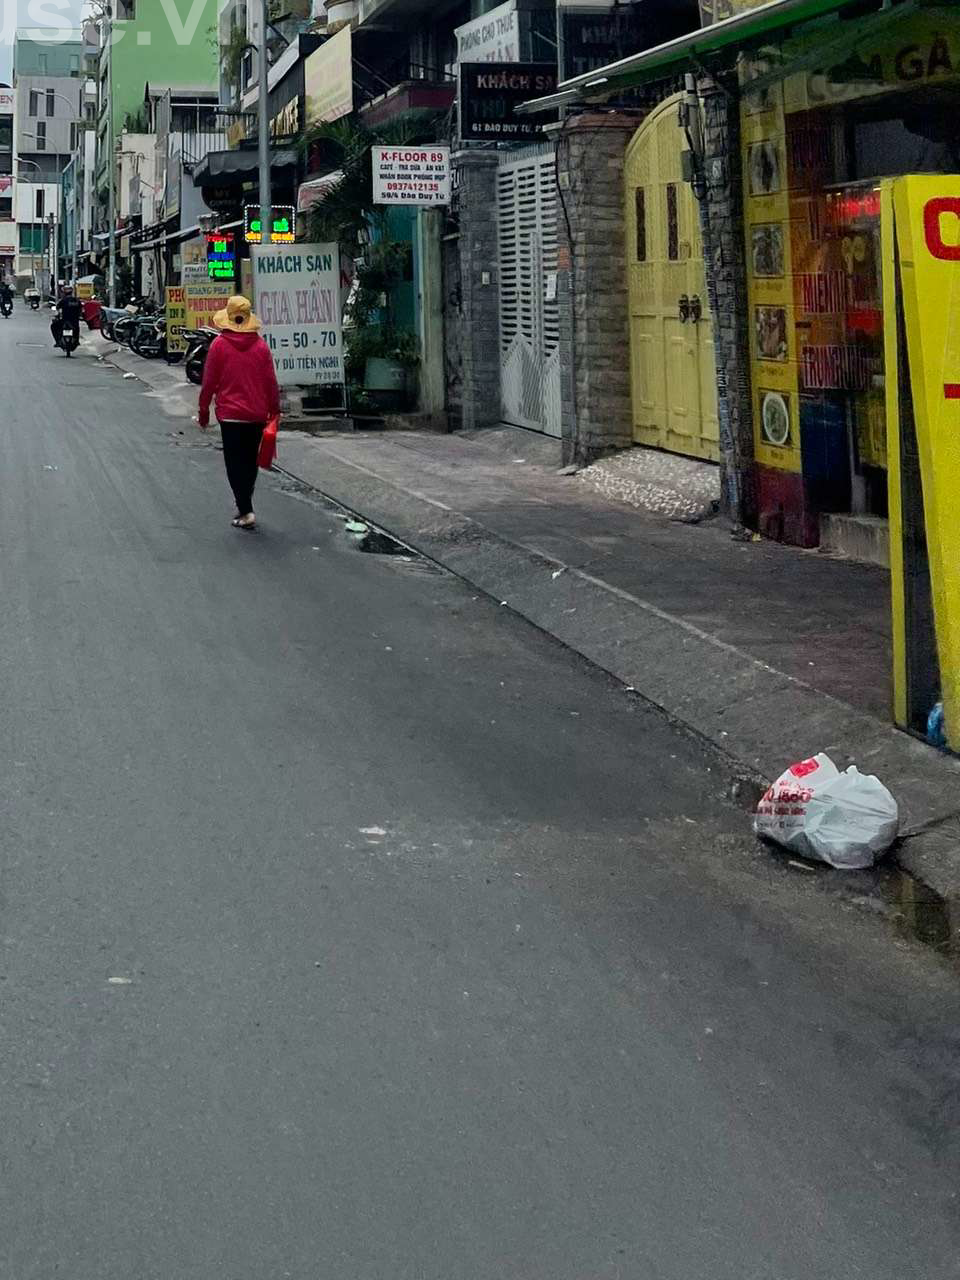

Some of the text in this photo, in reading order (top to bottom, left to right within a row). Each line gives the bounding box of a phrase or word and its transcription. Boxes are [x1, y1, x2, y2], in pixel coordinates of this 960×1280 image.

[381, 152, 427, 162] K-FLOOR
[257, 250, 302, 274] KHÁCH
[306, 254, 332, 276] SẠN
[259, 290, 291, 326] GIA
[293, 332, 308, 348] 50
[321, 331, 336, 347] 70
